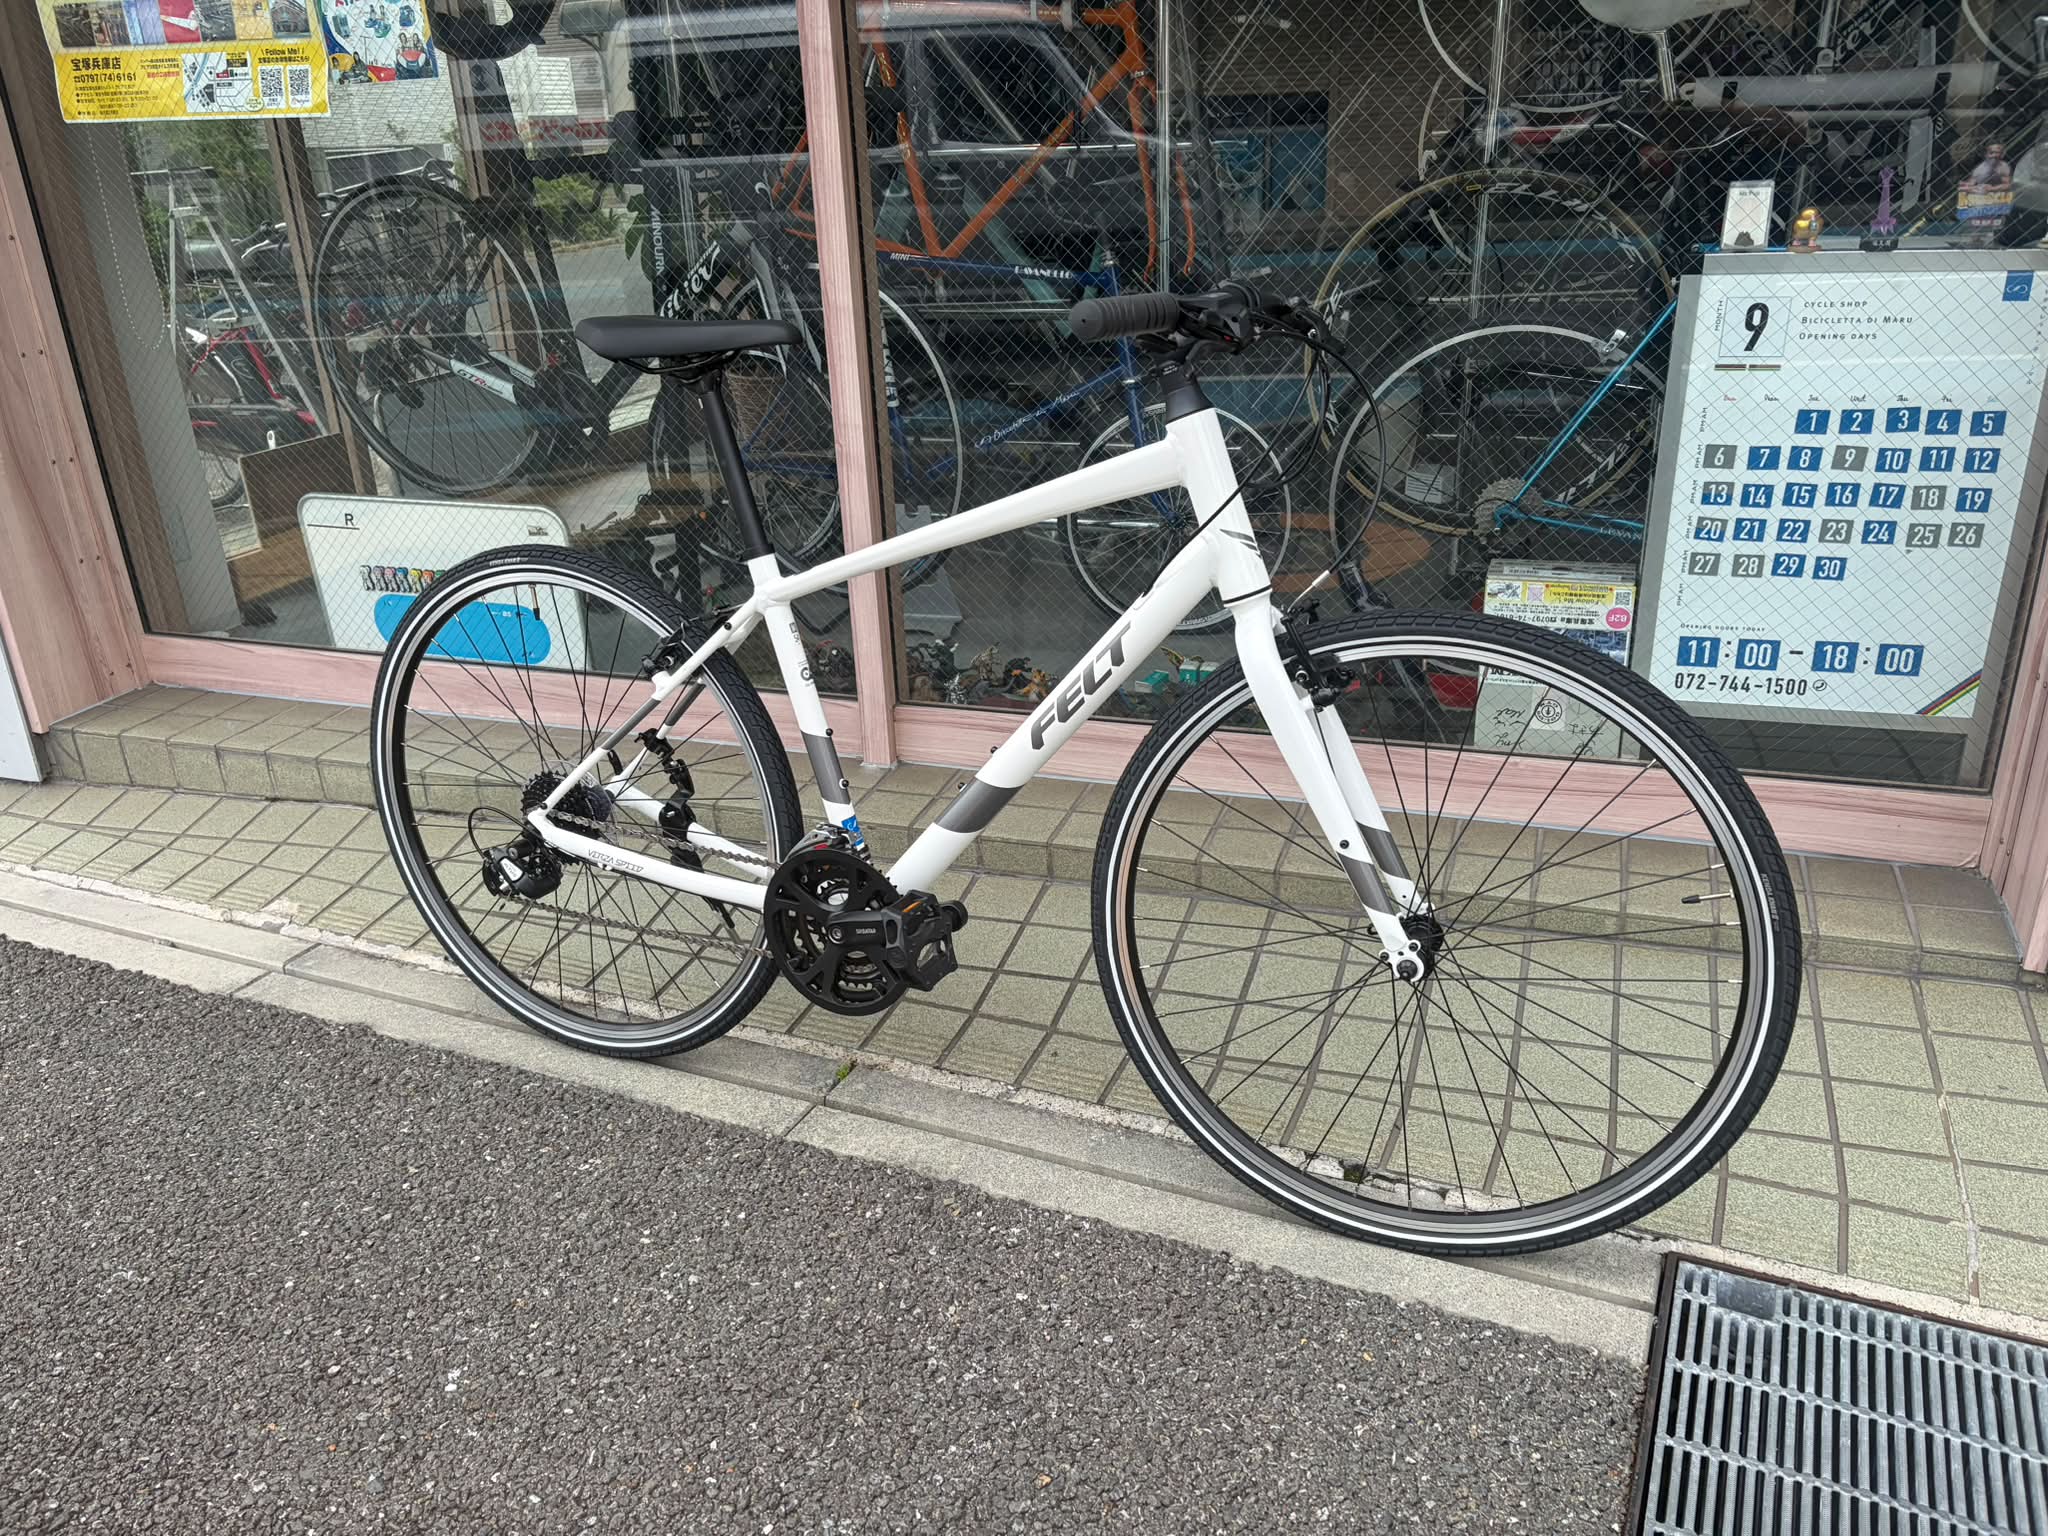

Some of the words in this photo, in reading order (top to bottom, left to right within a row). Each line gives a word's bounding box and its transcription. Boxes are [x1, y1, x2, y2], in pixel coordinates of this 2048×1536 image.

[70, 57, 122, 72] 宝塚兵庫店
[80, 72, 137, 83] 0797(74)6161
[650, 203, 666, 277] MINOURA
[1714, 300, 1724, 332] MONTH
[1803, 300, 1835, 308] CYCLE
[1839, 300, 1868, 308] SHOP
[1743, 302, 1770, 352] 9
[1809, 411, 1818, 431] 1
[1850, 411, 1863, 432] 2
[1897, 409, 1909, 430] 3
[1936, 412, 1949, 432] 4
[1981, 413, 1994, 433] 5
[1713, 447, 1725, 466] 6
[1759, 448, 1770, 467] 7
[1799, 448, 1811, 468] 8
[1843, 448, 1856, 468] 9
[1884, 450, 1904, 471] 10
[1929, 449, 1948, 469] 11
[1973, 450, 1993, 471] 12
[1708, 484, 1728, 503] 13
[1748, 486, 1766, 506] 14
[1791, 485, 1811, 505] 15
[1834, 485, 1853, 505] 16
[1879, 486, 1899, 506] 17
[1919, 488, 1939, 508] 18
[1964, 490, 1985, 510] 19
[343, 513, 355, 527] R
[1699, 519, 1722, 539] 20
[1739, 520, 1760, 539] 21
[1781, 521, 1805, 541] 22
[1824, 522, 1847, 541] 23
[1867, 523, 1889, 543] 24
[1911, 526, 1936, 546] 25
[1953, 525, 1977, 546] 26
[1694, 555, 1716, 574] 27
[1737, 557, 1759, 575] 28
[1776, 556, 1800, 575] 29
[1818, 559, 1841, 578] 30
[1576, 597, 1600, 606] Follow
[1607, 613, 1628, 622] B2F
[1030, 620, 1132, 750] FELT
[1674, 672, 1808, 696] 072-744-1500
